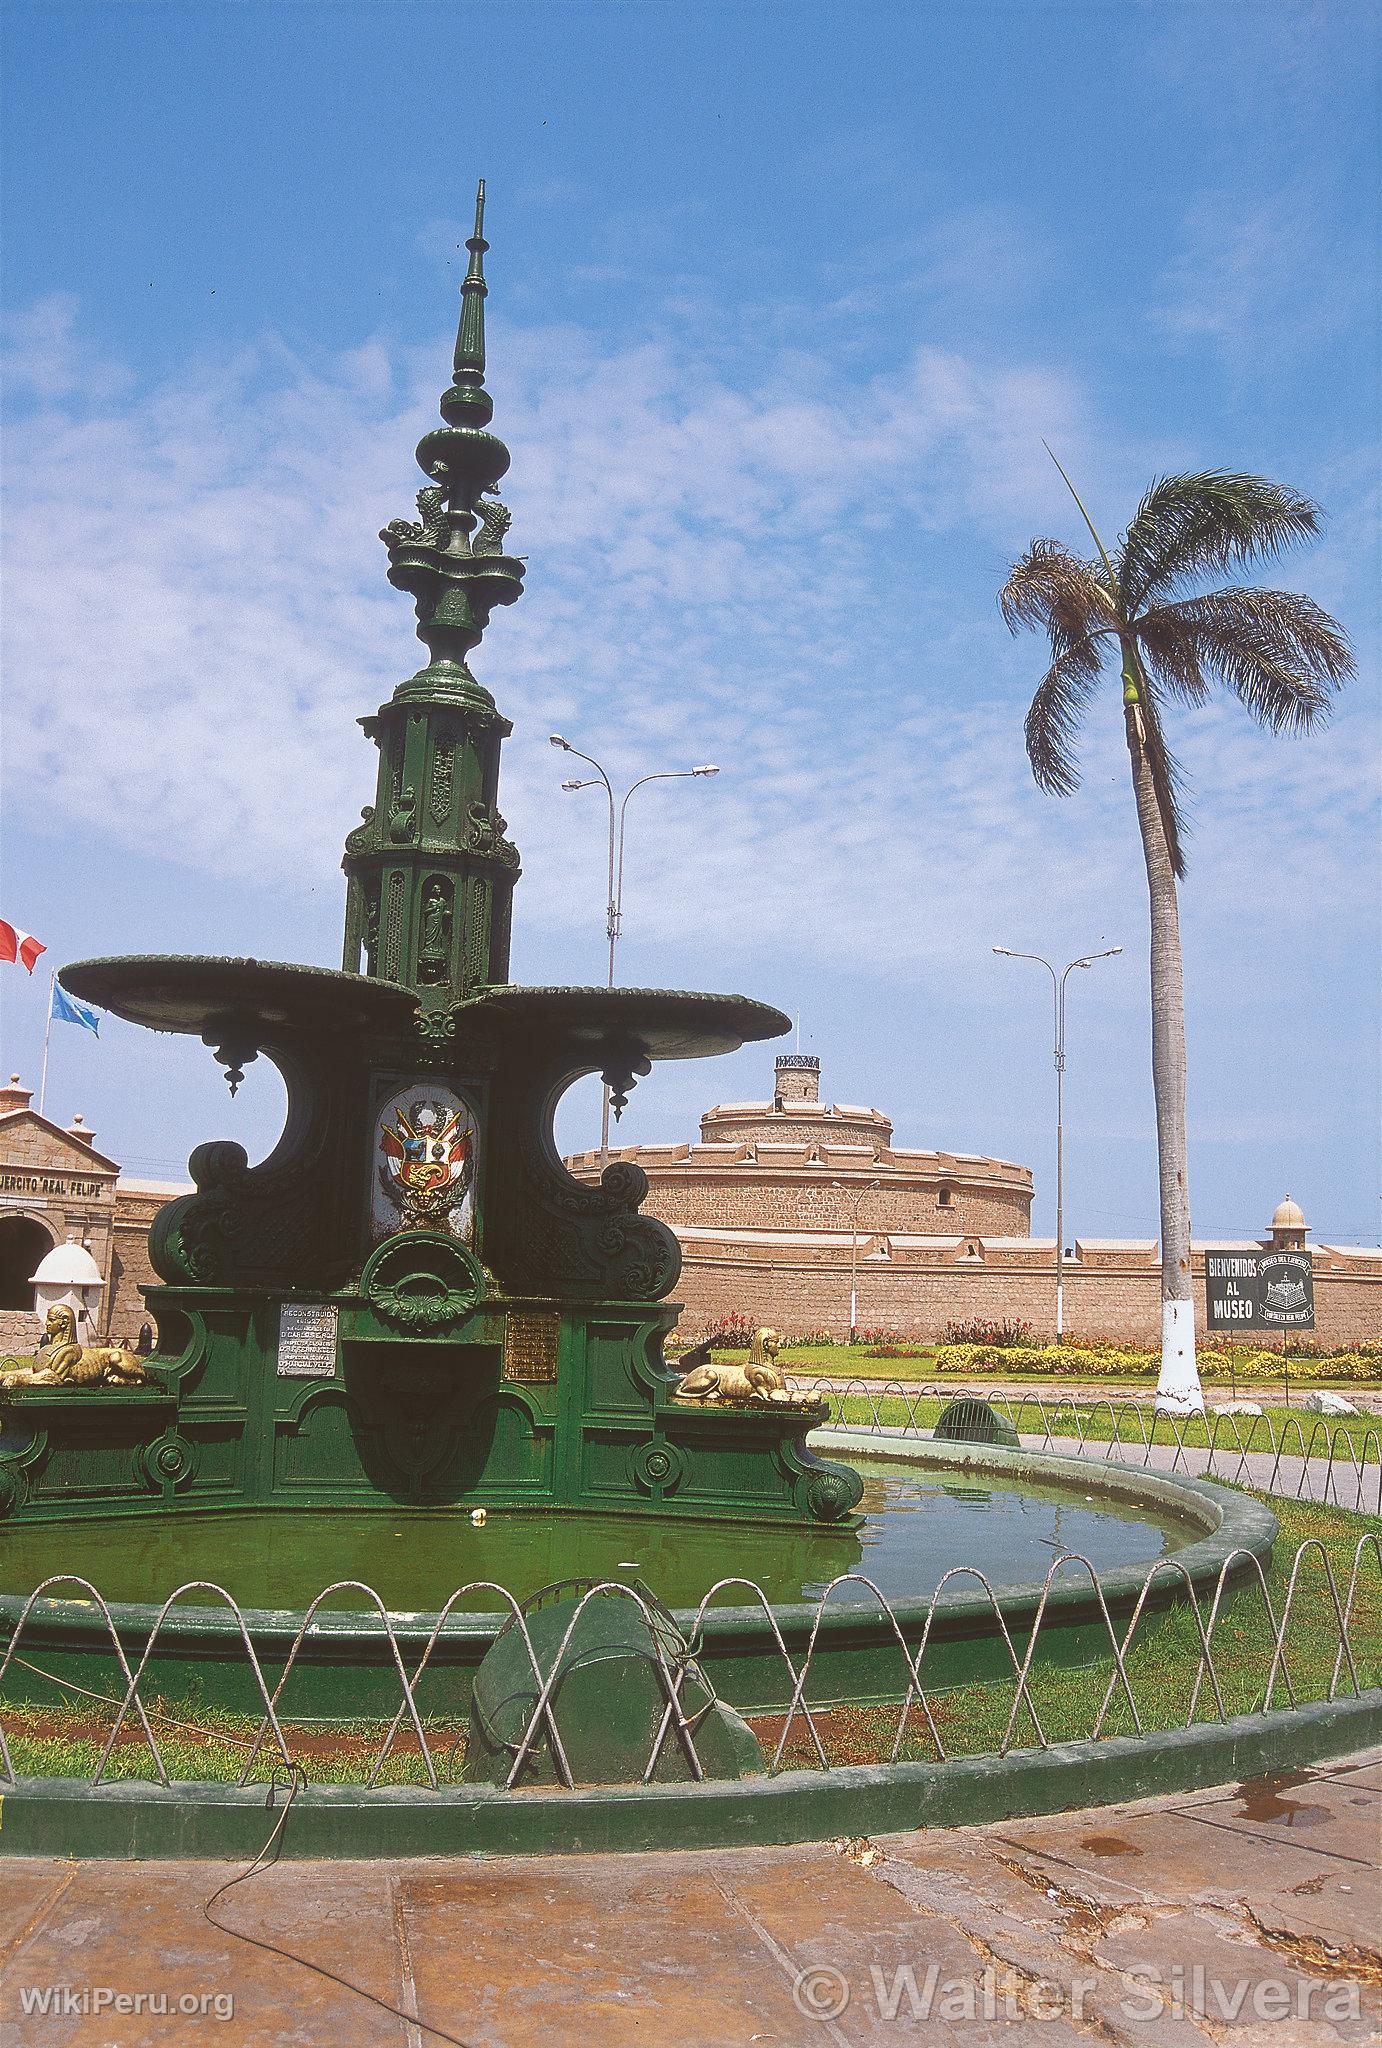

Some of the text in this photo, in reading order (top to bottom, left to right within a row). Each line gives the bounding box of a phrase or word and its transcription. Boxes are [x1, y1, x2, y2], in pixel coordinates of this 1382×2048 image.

[1209, 1258, 1257, 1277] BIENVENIDOS
[1226, 1281, 1240, 1296] AL
[1213, 1300, 1253, 1319] MUSEO
